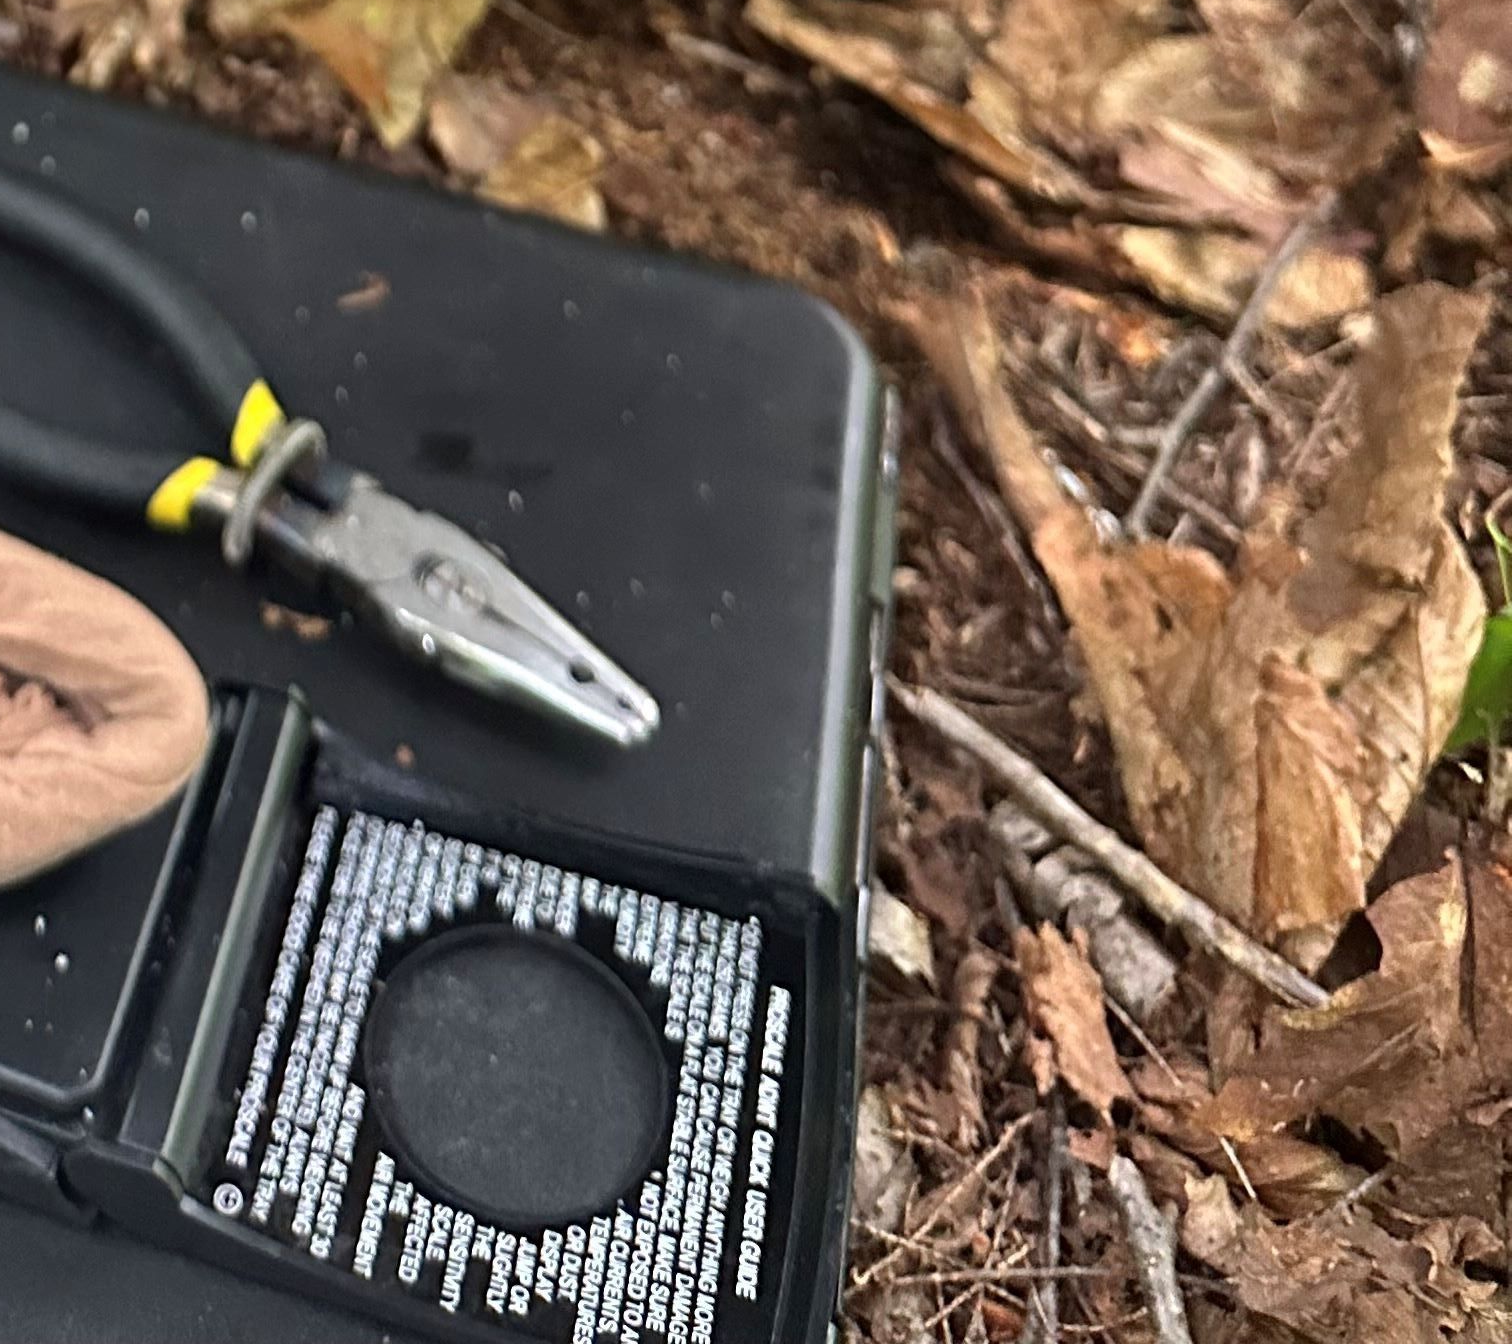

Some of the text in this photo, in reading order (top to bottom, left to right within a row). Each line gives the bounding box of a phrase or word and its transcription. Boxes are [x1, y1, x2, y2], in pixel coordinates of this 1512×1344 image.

[689, 972, 711, 1020] SCALE
[680, 1056, 700, 1095] FLAT
[724, 1055, 745, 1085] THE
[227, 1071, 266, 1165] PROSCALE
[339, 1083, 364, 1120] AND
[670, 1095, 694, 1153] STABLE
[699, 1083, 719, 1117] CAN
[720, 1087, 740, 1126] TRAY
[274, 1127, 308, 1192] ALWAYS
[329, 1119, 356, 1161] WAIT
[691, 1118, 714, 1171] CAUSE
[749, 1130, 772, 1185] QUICK
[322, 1158, 347, 1182] AT
[373, 1152, 394, 1183] AIR
[710, 1154, 731, 1208] WEIGH
[251, 1178, 275, 1220] TRAY
[292, 1153, 325, 1234] WEIGHING
[316, 1181, 341, 1235] LEAST
[388, 1181, 412, 1215] THE
[640, 1182, 659, 1219] NOT
[743, 1190, 765, 1239] USER
[355, 1183, 387, 1276] MOVEMENT
[399, 1195, 429, 1281] AFFECTED
[467, 1223, 494, 1259] THE
[565, 1225, 585, 1252] OR
[679, 1172, 706, 1271] PERMANENT
[441, 1212, 473, 1310] SENSITIVITY
[486, 1232, 515, 1311] SLIGHTLY
[515, 1237, 536, 1285] JUMP
[535, 1230, 561, 1300] DISPLAY
[628, 1219, 654, 1298] EXPOSED
[653, 1234, 675, 1282] MAKE
[698, 1207, 723, 1291] ANYTHING
[736, 1240, 760, 1298] GUIDE
[508, 1285, 529, 1314] OR
[623, 1298, 643, 1325] TO
[646, 1283, 669, 1331] SURE
[668, 1273, 693, 1343] DAMAGE
[691, 1293, 713, 1343] MORE
